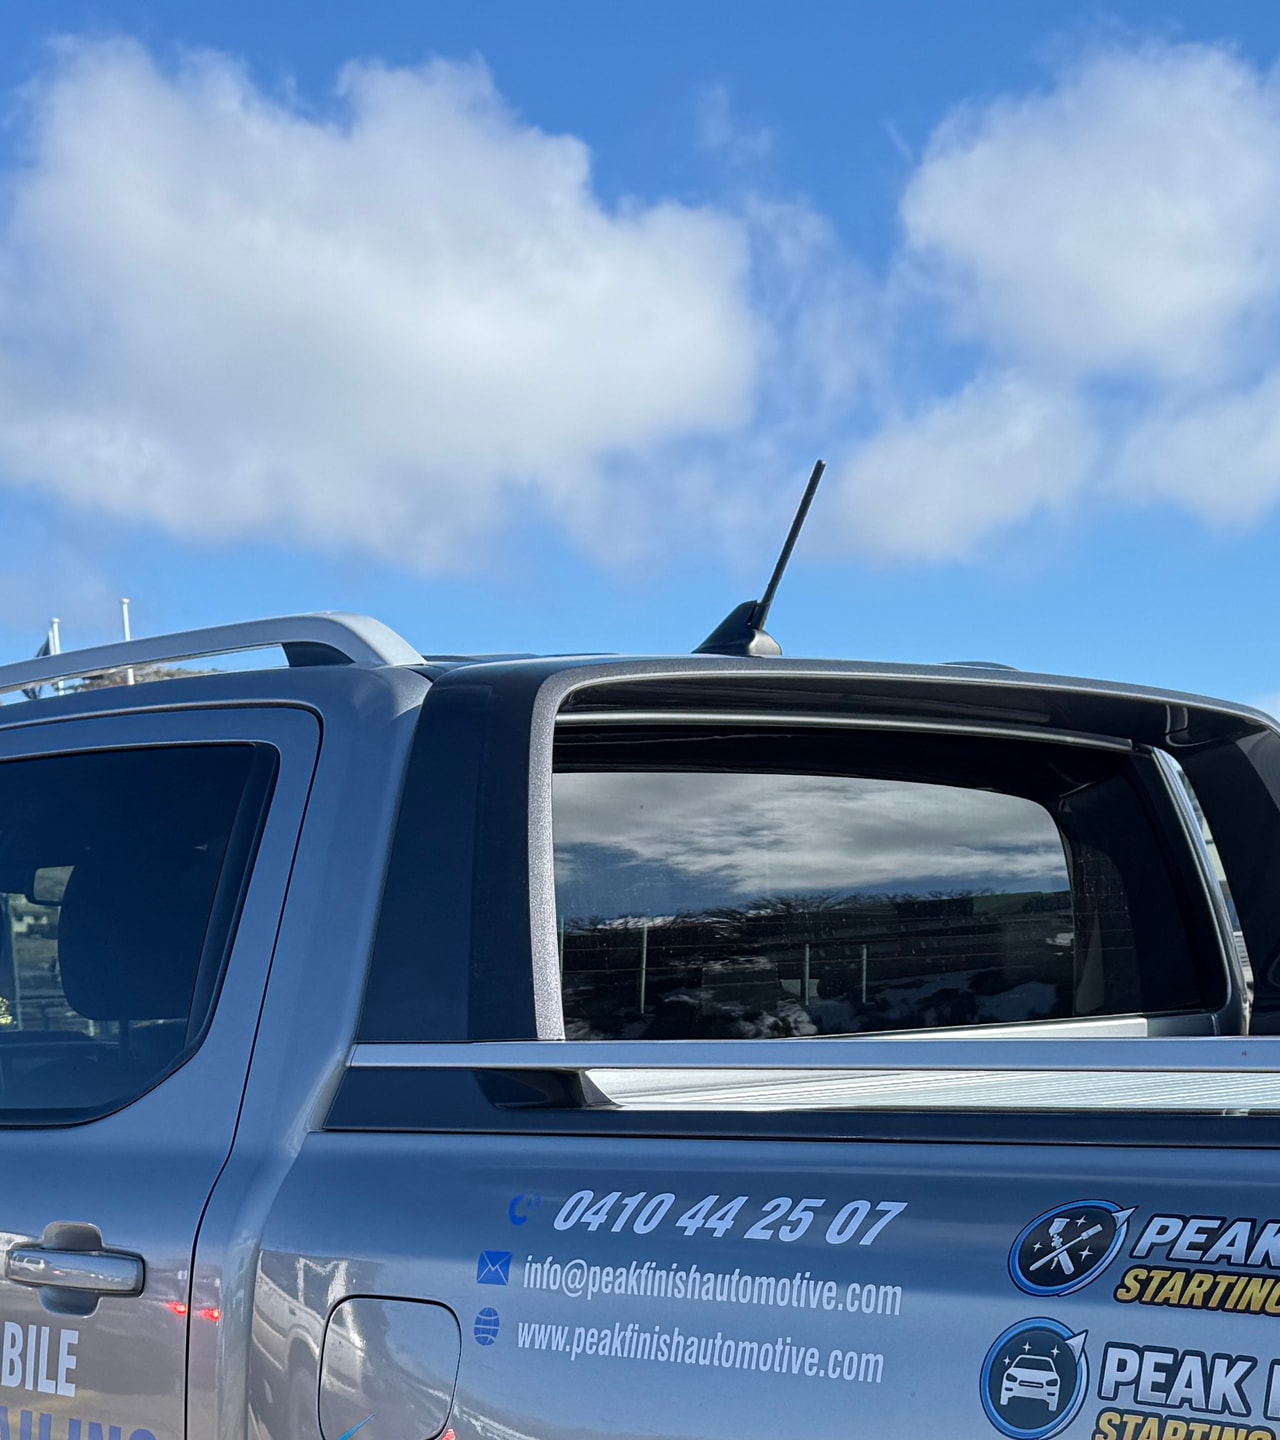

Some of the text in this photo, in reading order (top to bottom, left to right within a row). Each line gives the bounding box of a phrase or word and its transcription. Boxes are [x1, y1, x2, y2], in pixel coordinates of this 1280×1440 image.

[553, 1190, 908, 1246] 0410 44 25 07
[523, 1255, 903, 1316] info@peakfinishautomotive.com
[517, 1319, 885, 1383] www.peakfinishautomotive.com
[1097, 1344, 1253, 1416] PEAK
